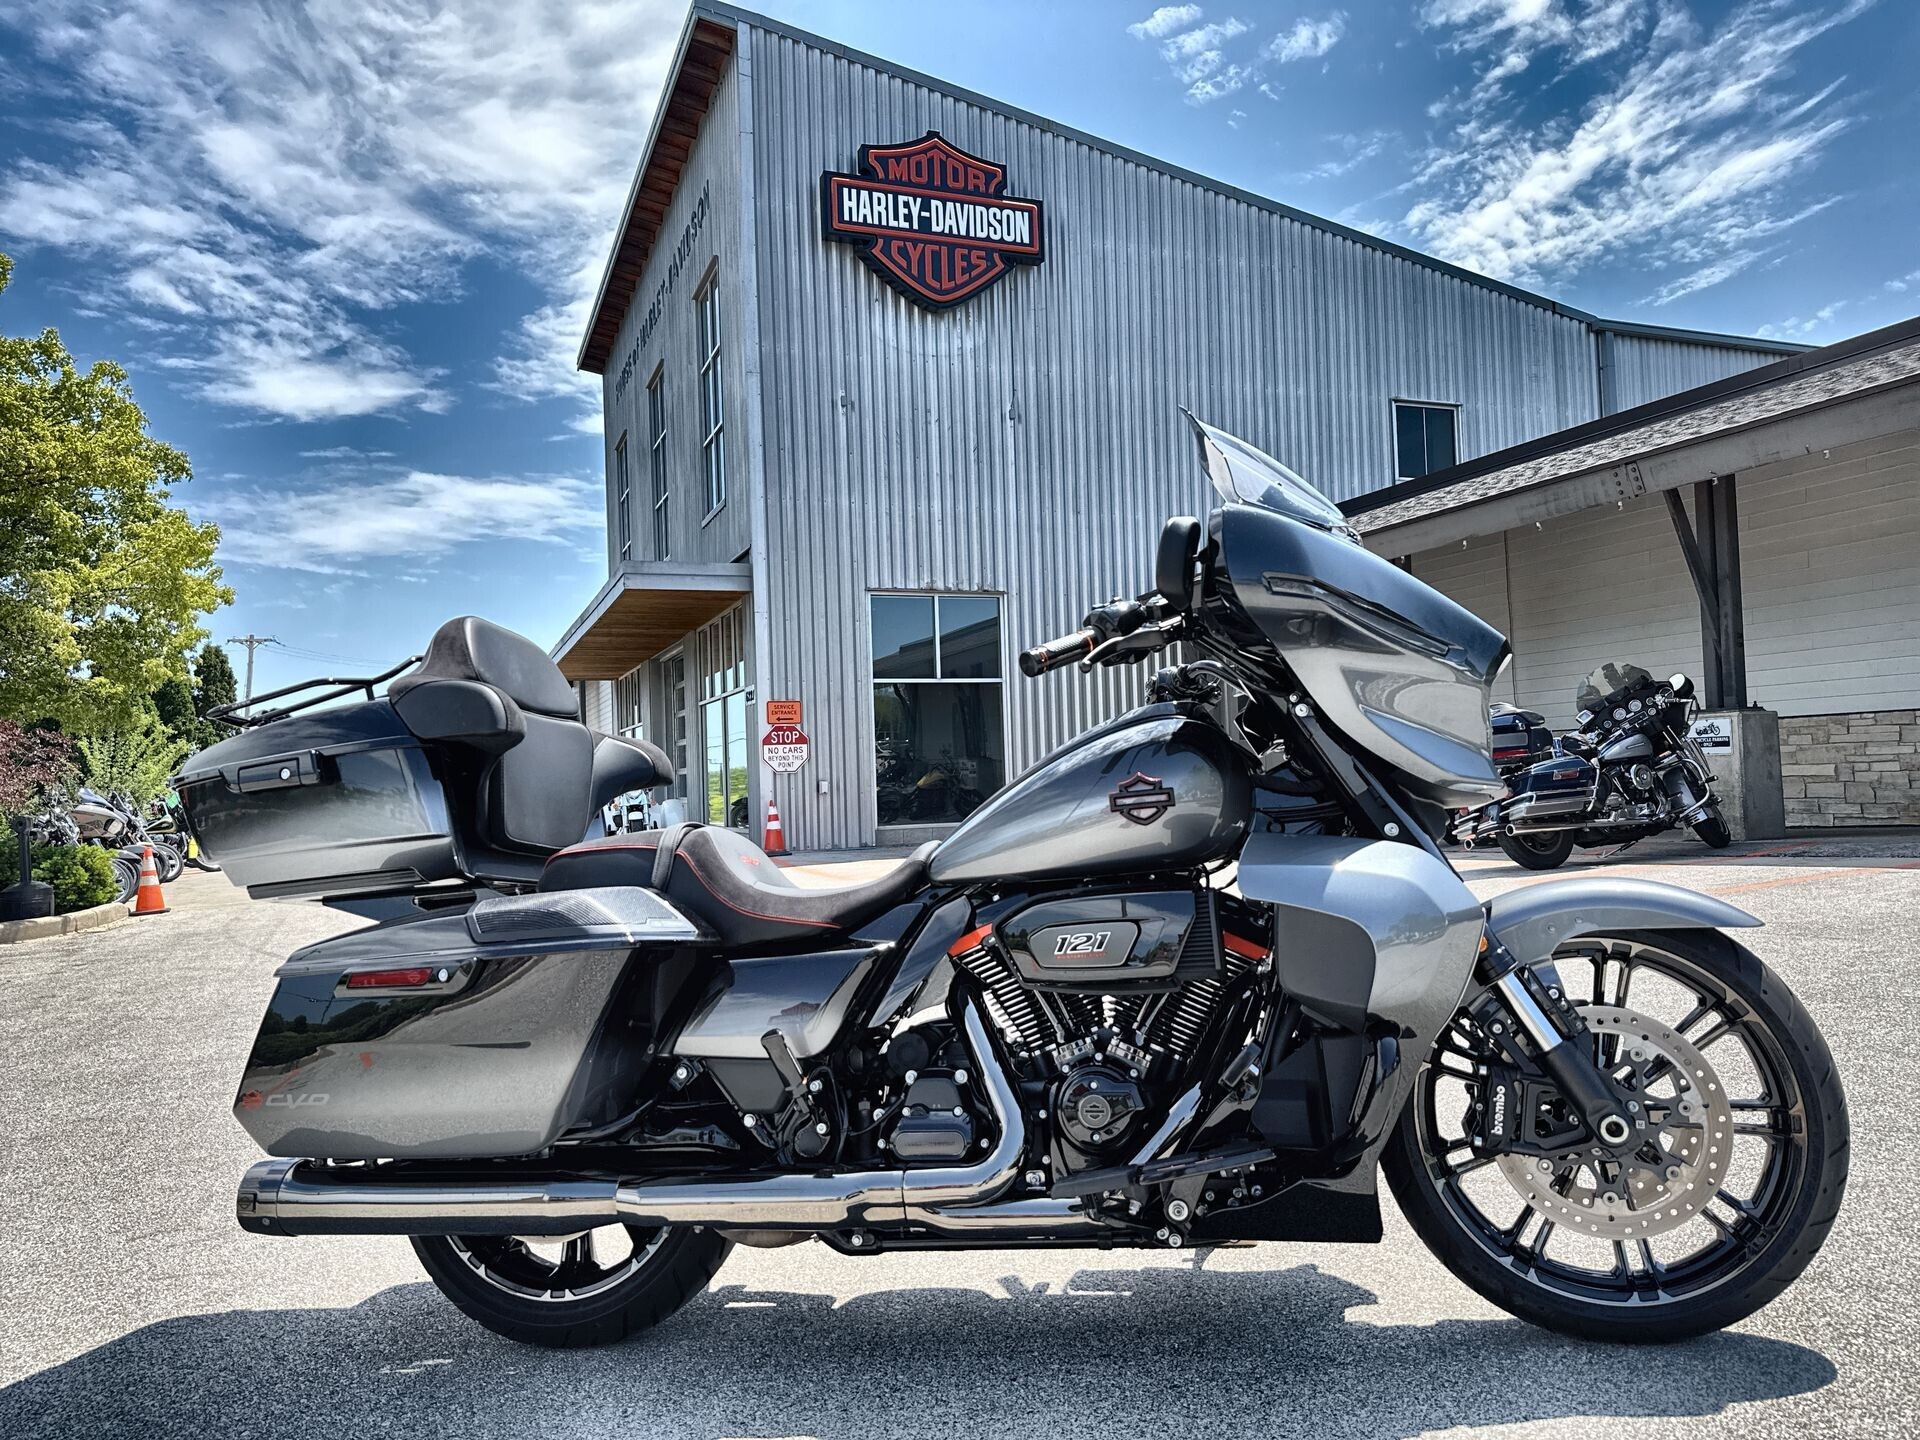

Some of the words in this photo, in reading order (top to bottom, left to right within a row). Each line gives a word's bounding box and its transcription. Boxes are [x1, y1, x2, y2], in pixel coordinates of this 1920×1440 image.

[888, 149, 986, 194] MOTOR
[842, 187, 1030, 244] HARLEY-DAVIDSON
[890, 240, 987, 291] CYCLES
[771, 731, 800, 743] STOP
[782, 746, 804, 754] CARS
[1054, 931, 1111, 955] 121
[265, 1093, 330, 1109] CVO
[1491, 1085, 1506, 1136] brembo
